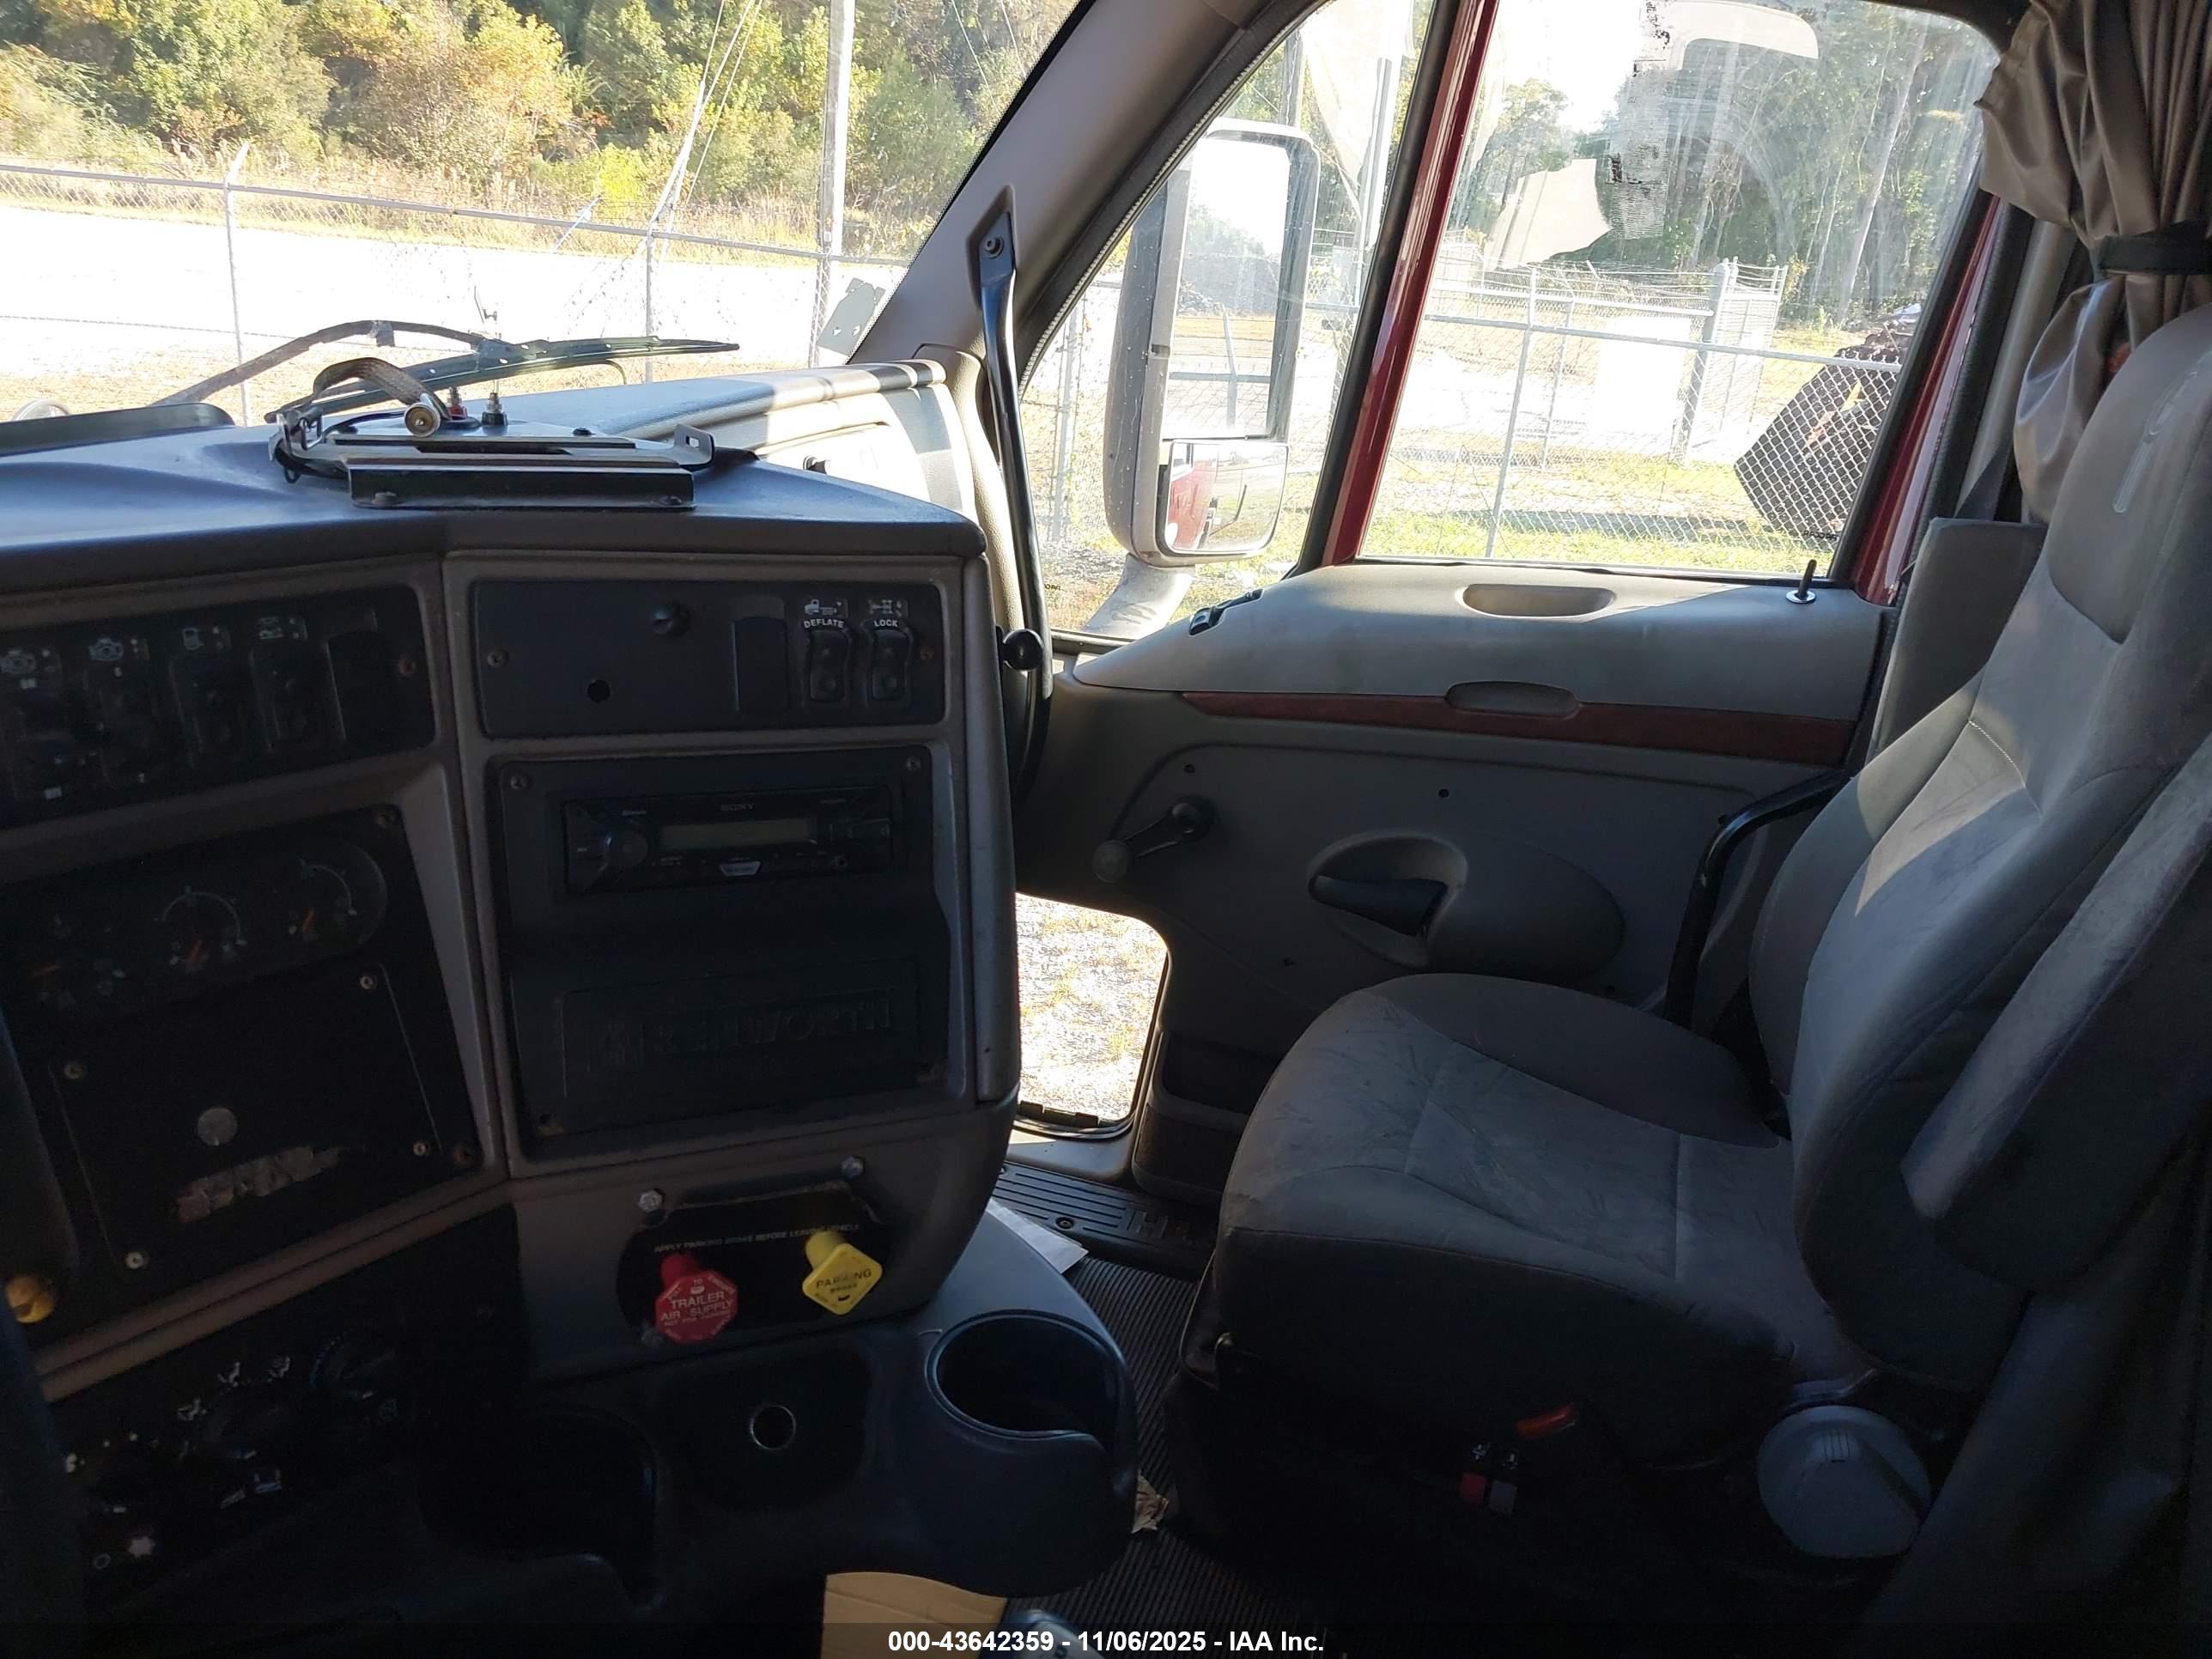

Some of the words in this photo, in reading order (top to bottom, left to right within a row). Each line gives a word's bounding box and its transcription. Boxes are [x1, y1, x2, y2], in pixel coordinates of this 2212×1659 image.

[803, 617, 845, 629] DEFLATE
[873, 619, 898, 628] LOCK
[816, 1268, 872, 1289] PARNG
[671, 1291, 725, 1310] TRAILER
[660, 1310, 681, 1322] AIR
[690, 1299, 734, 1316] SUPPLY
